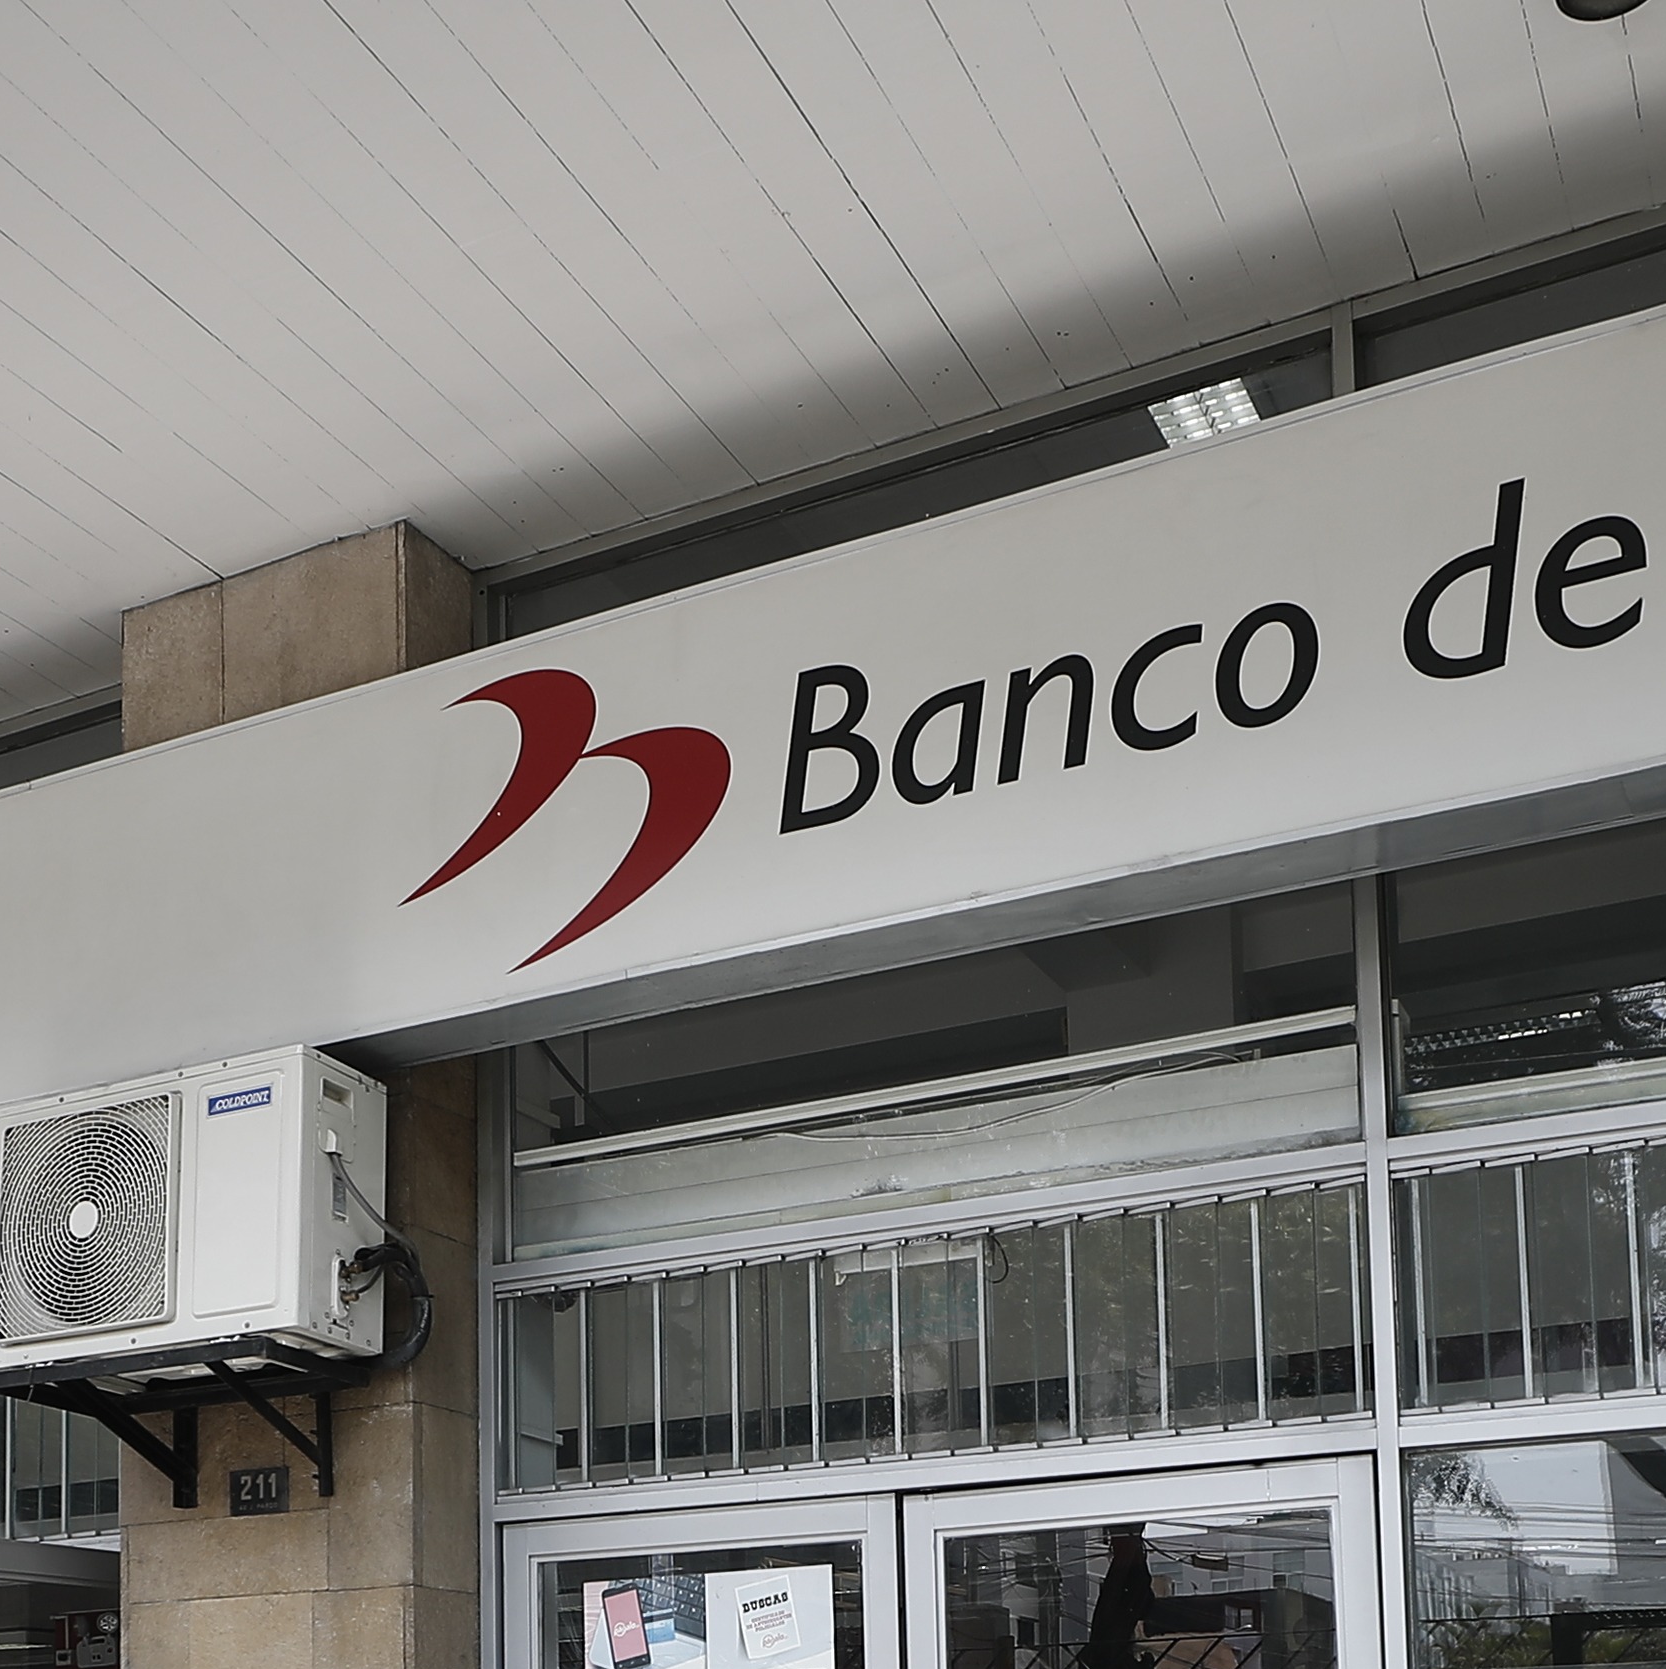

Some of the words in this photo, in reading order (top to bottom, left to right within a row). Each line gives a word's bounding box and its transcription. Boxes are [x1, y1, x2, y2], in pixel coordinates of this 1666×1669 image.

[780, 603, 1318, 834] Banco
[1404, 478, 1646, 679] de
[240, 1473, 277, 1500] 211
